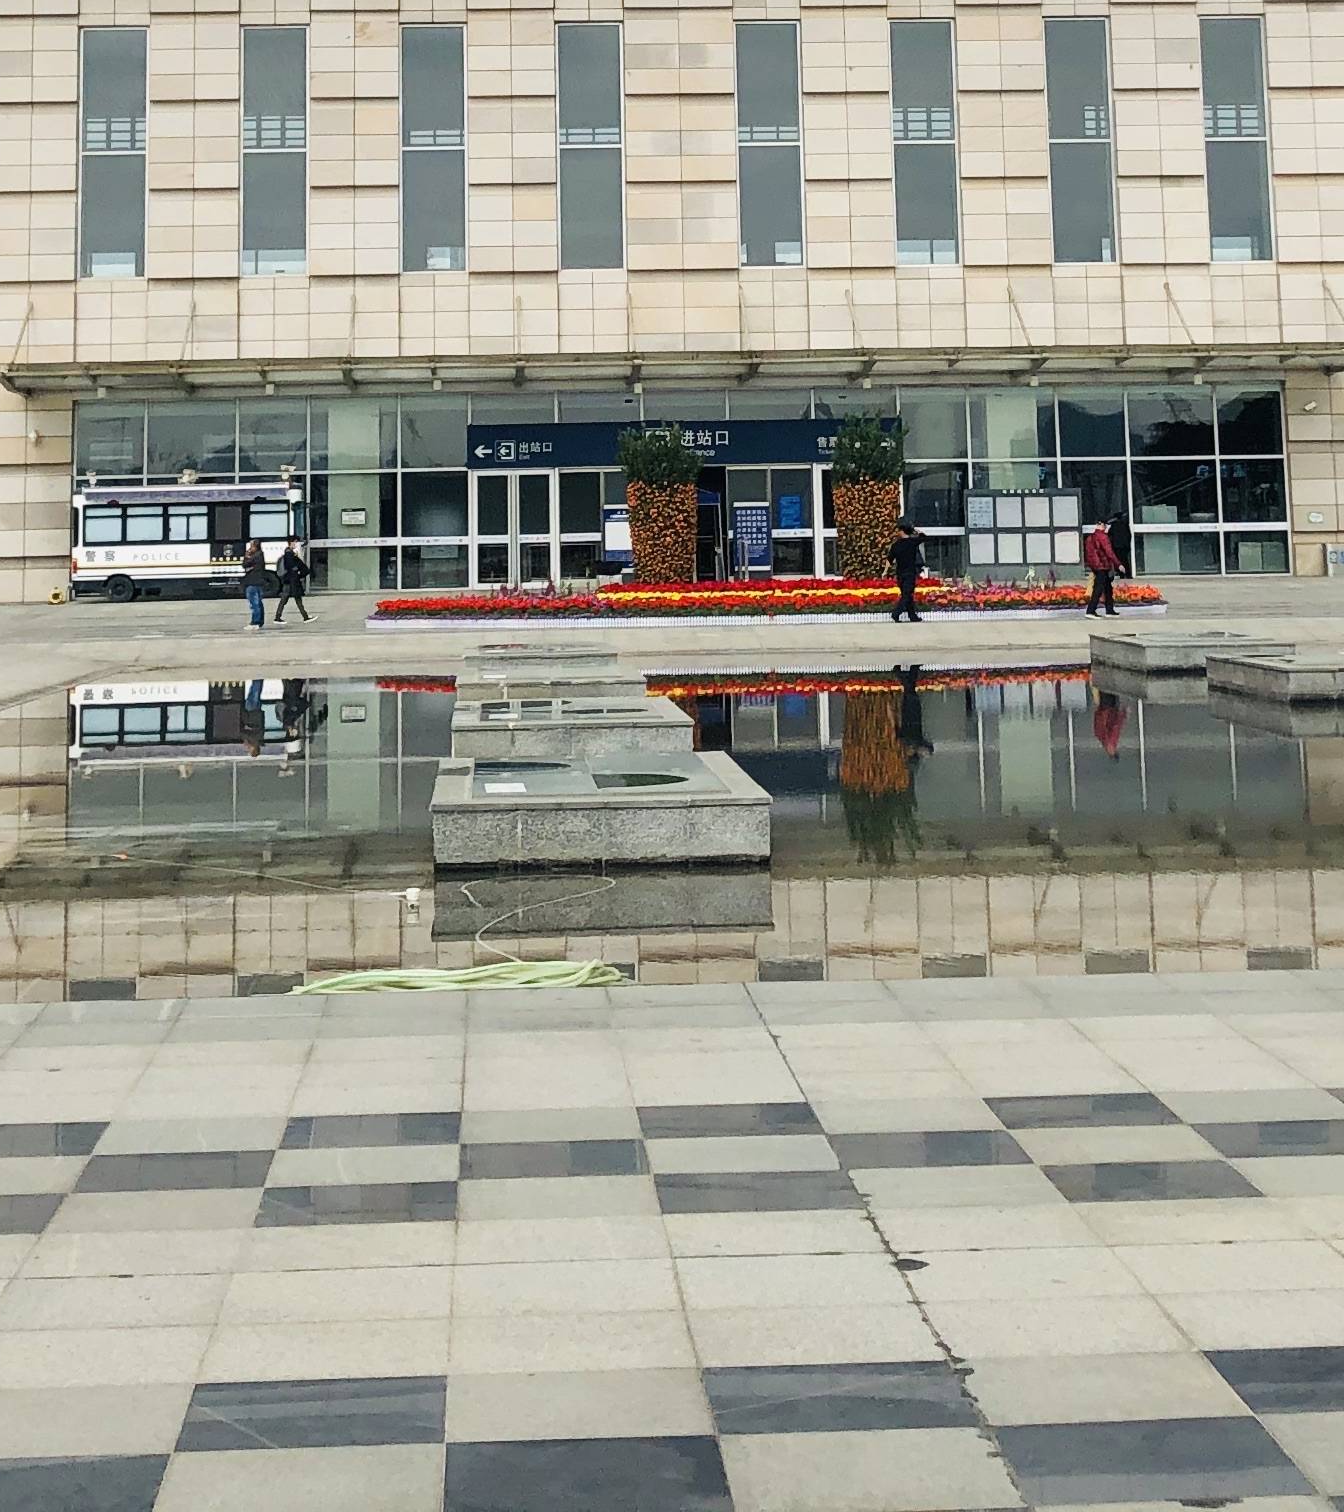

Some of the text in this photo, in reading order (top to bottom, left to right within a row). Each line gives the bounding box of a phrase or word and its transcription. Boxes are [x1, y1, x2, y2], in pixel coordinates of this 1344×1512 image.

[680, 430, 729, 446] 进站口
[519, 441, 552, 453] 出站口
[86, 551, 115, 562] 警察
[133, 552, 179, 561] POLICE
